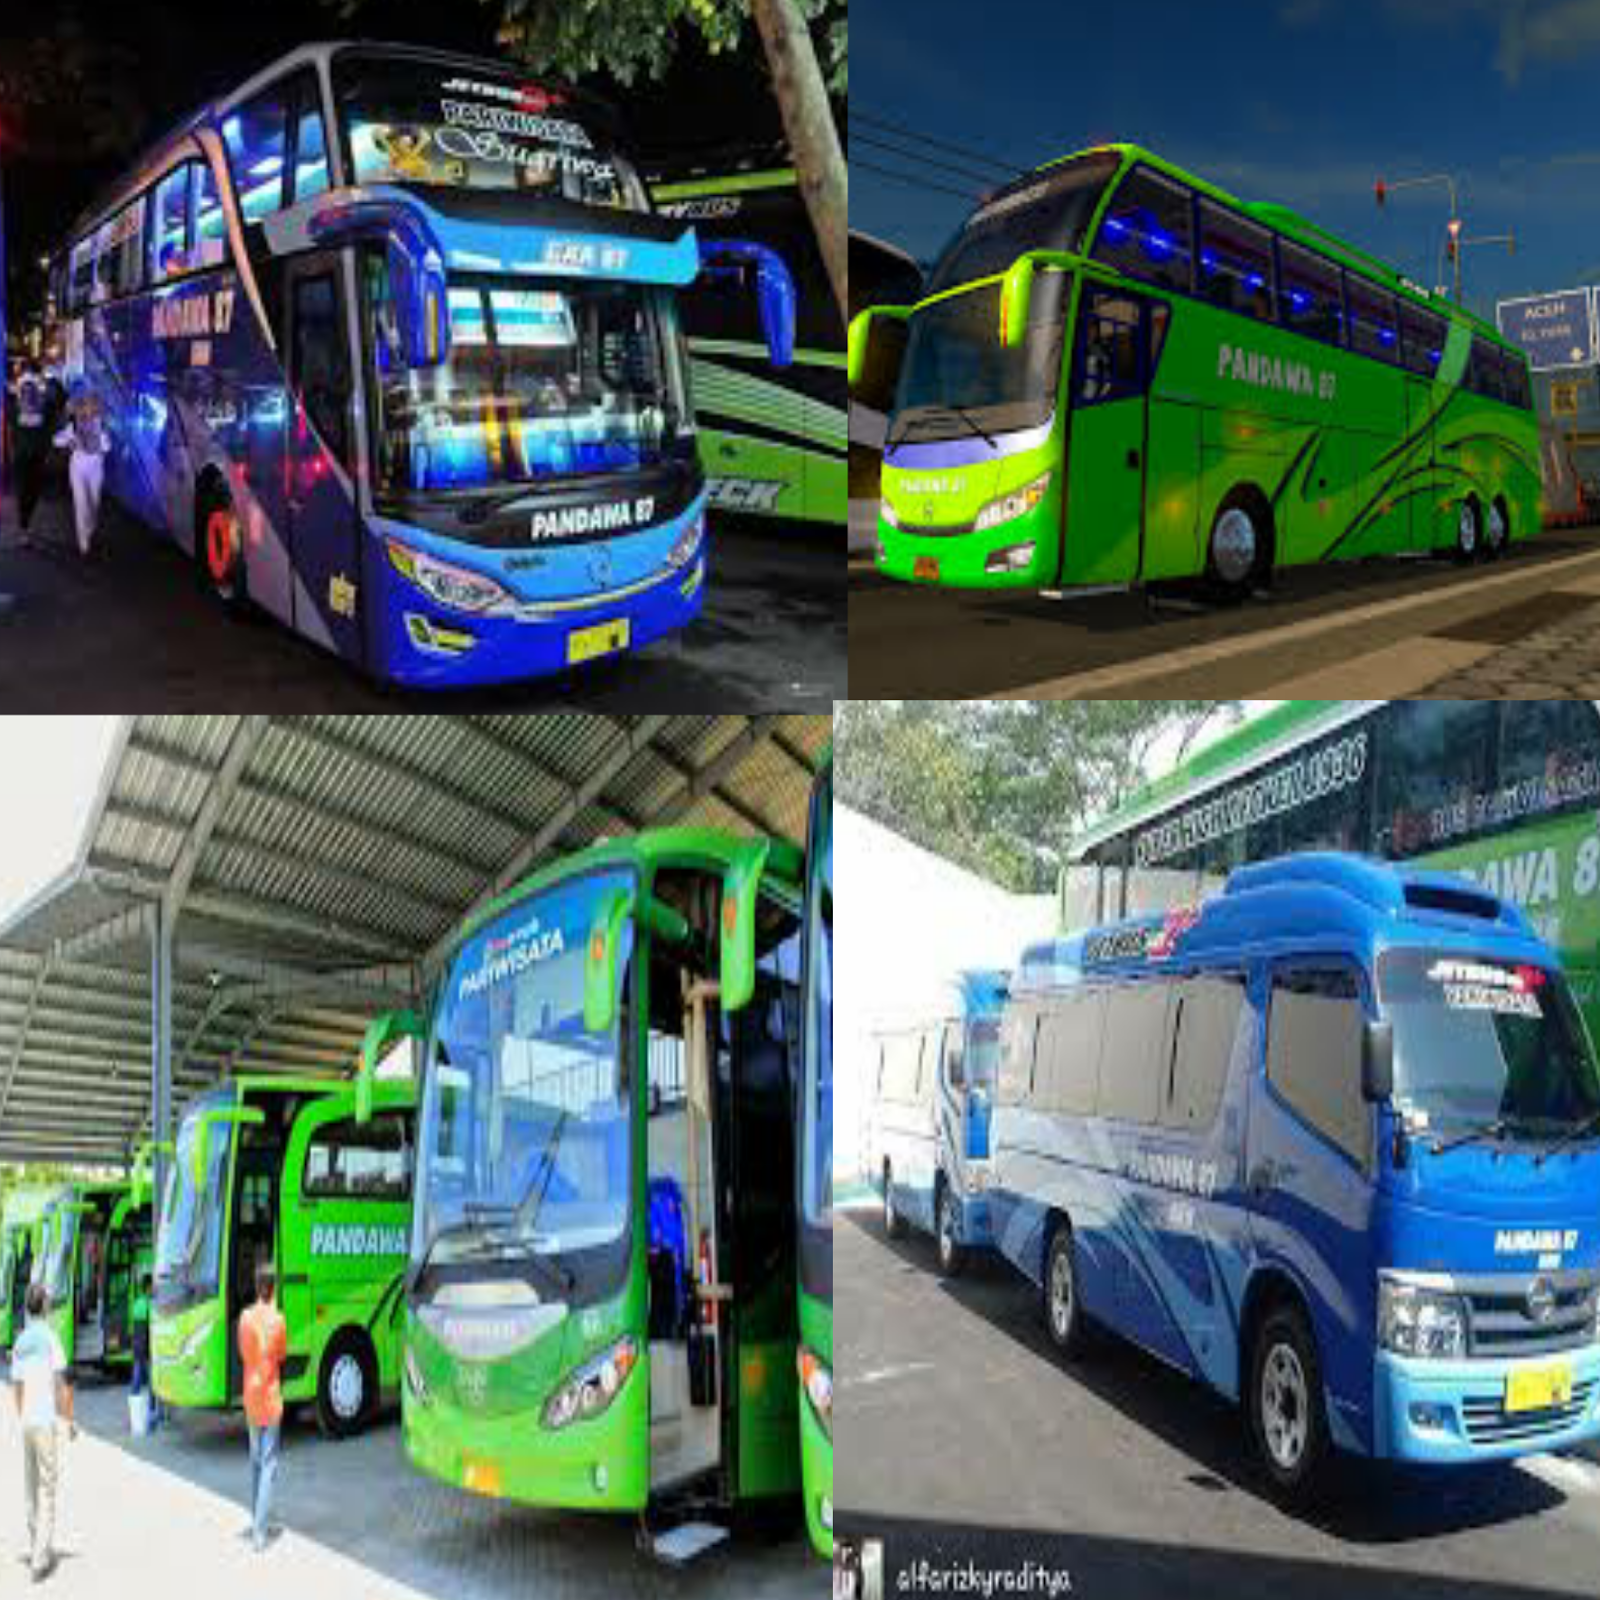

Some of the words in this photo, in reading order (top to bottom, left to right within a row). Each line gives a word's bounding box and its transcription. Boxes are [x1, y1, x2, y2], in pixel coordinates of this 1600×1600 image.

[1217, 344, 1314, 396] PANDAWA
[531, 500, 631, 541] PANDAWA
[635, 496, 655, 522] 87
[1573, 835, 1600, 897] 8
[459, 927, 564, 1001] PARIWISATA
[311, 1224, 406, 1255] PANDAWA
